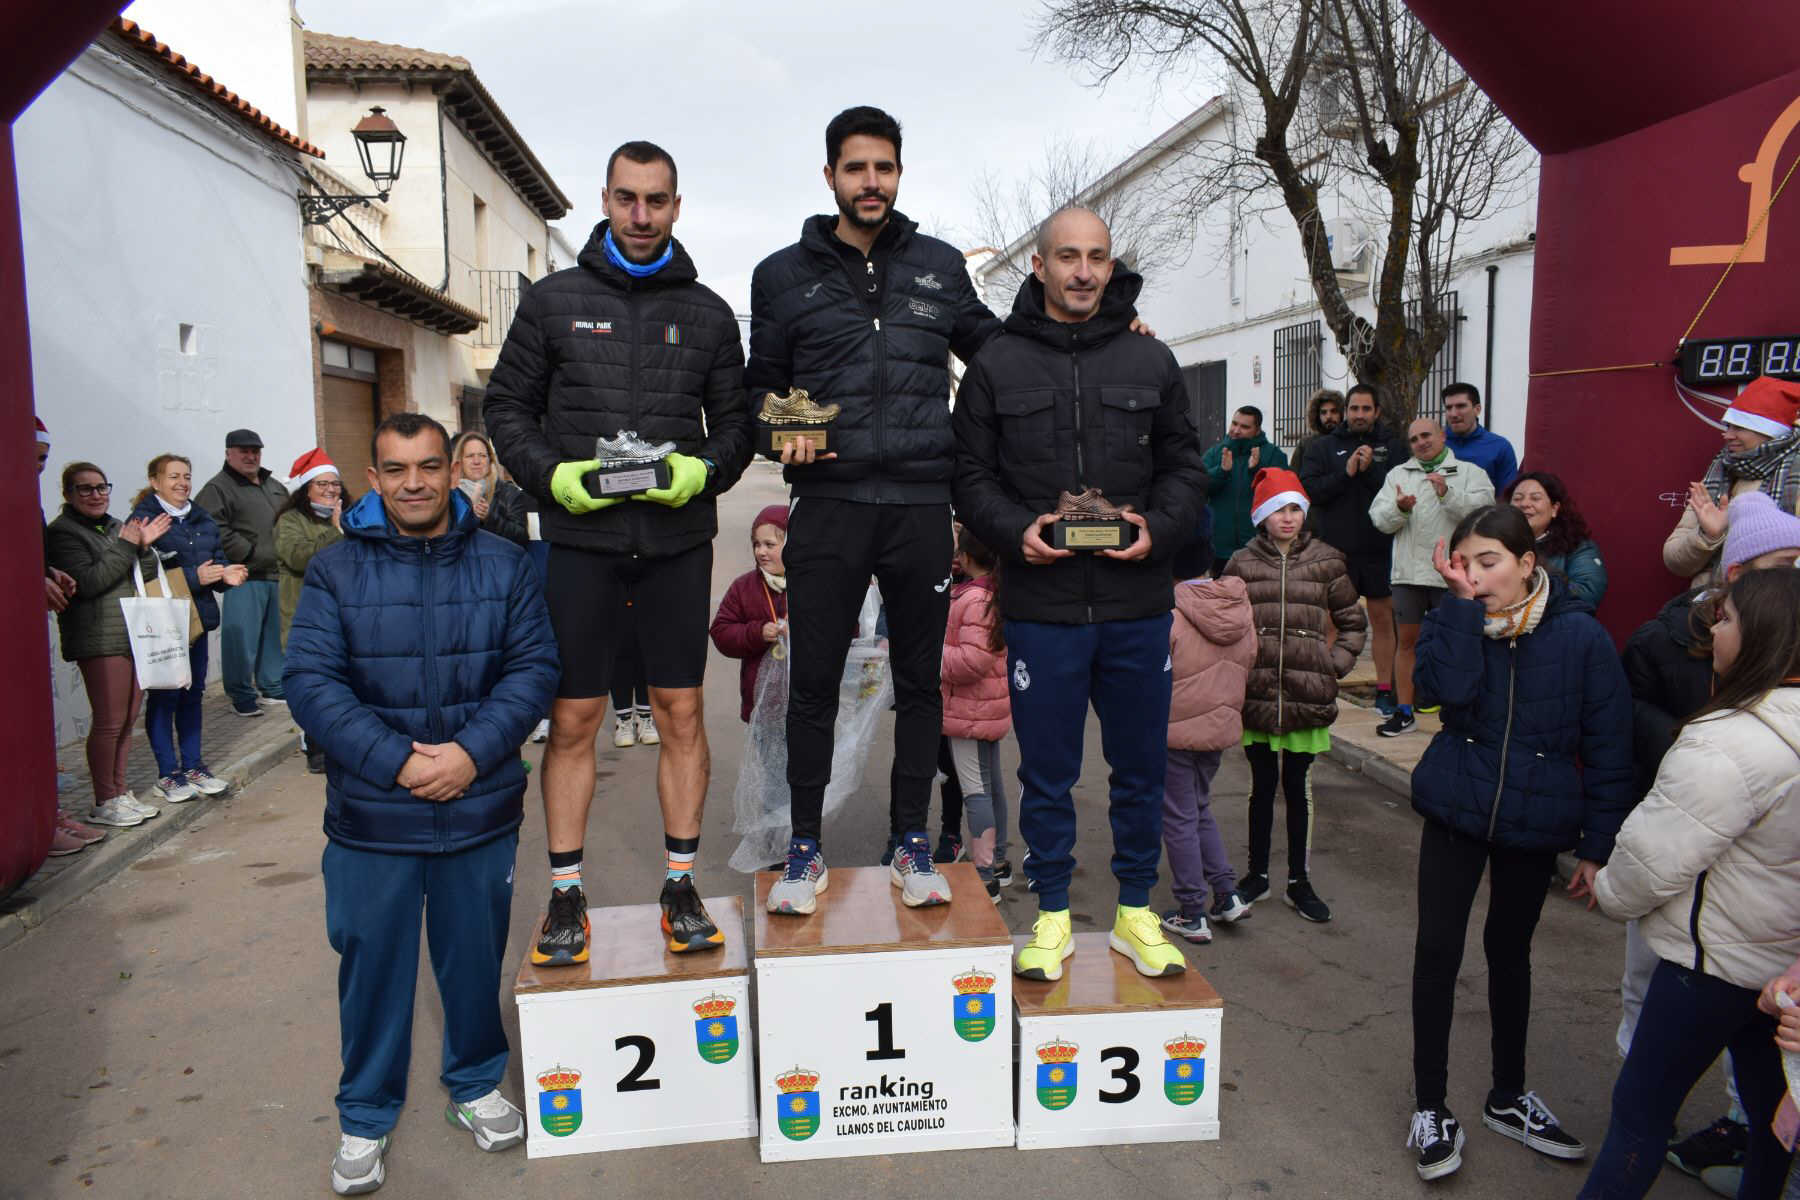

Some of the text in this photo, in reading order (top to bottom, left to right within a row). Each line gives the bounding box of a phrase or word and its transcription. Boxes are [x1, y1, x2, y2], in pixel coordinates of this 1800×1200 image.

[596, 321, 612, 329] PARK
[865, 1002, 906, 1061] 1
[615, 1034, 661, 1093] 2
[1098, 1046, 1141, 1104] 3
[839, 1074, 934, 1100] ranking
[833, 1098, 948, 1118] EXCMO. AYUNTAMIENTO
[836, 1117, 945, 1136] LLANOS DEL CAUDILLO
